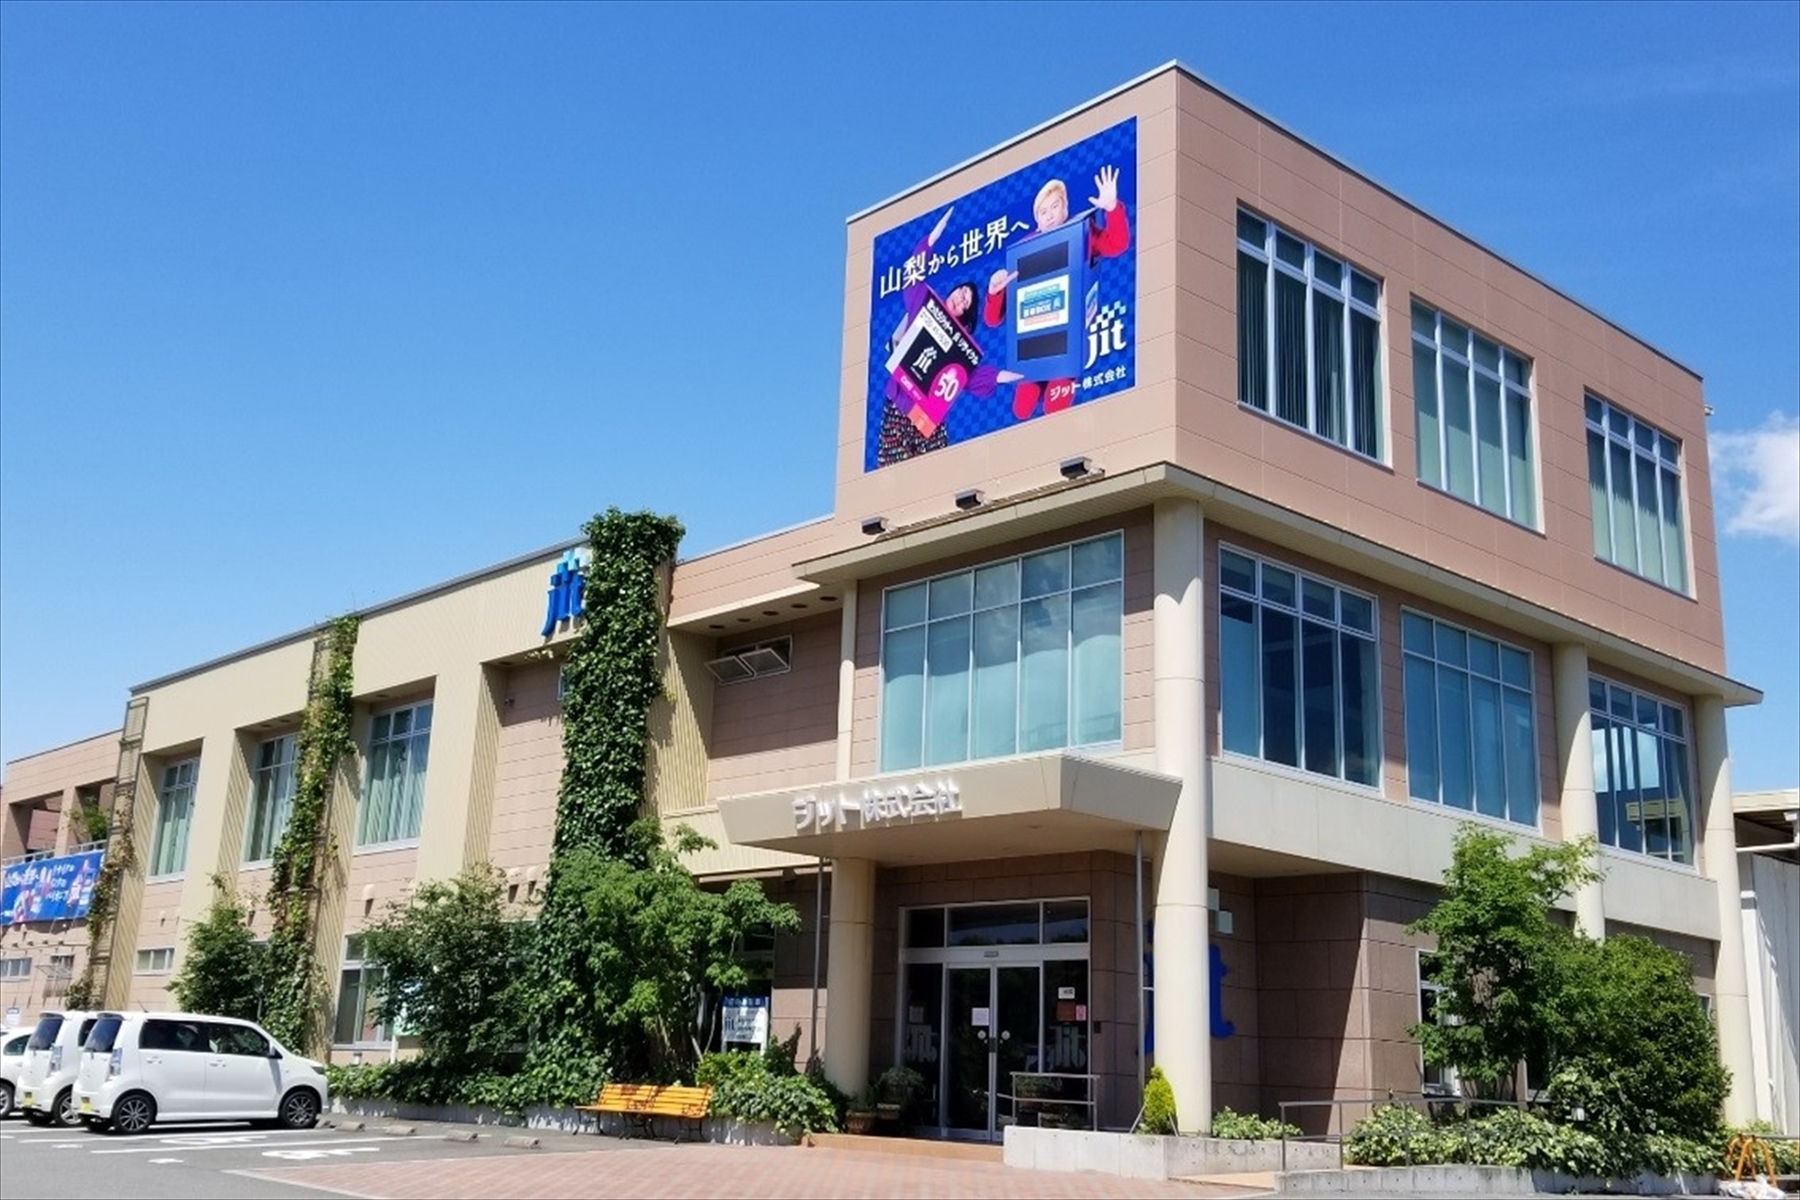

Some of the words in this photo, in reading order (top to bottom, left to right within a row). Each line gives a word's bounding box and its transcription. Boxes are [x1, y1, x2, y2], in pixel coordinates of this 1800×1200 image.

[880, 216, 1030, 298] 山梨から世界へ
[1084, 304, 1127, 370] jit
[934, 373, 959, 402] 50
[1050, 365, 1127, 402] ジット株式会社
[792, 779, 962, 830] ジット株式会社
